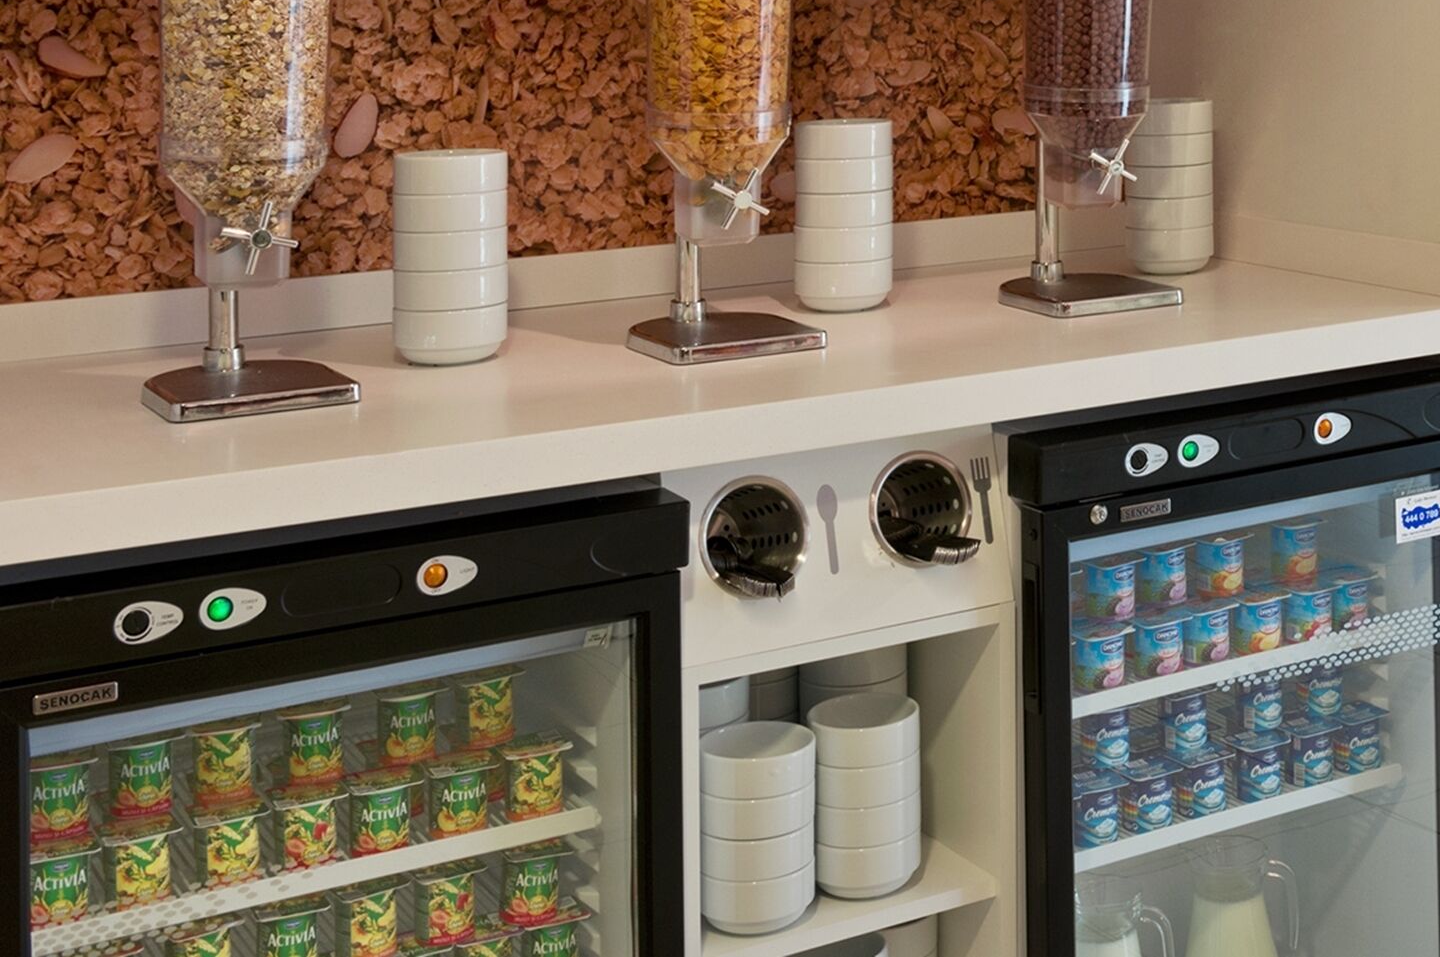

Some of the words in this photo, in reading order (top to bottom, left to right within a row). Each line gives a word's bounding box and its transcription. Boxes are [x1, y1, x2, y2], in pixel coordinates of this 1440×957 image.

[1124, 502, 1169, 520] SENOCAK
[40, 687, 112, 711] SENOCAK
[390, 708, 435, 730] ACTIVIA
[291, 727, 339, 748] ACTIVIA
[121, 755, 170, 779] ACTIVIA
[33, 778, 86, 801] ACTIVIA
[441, 782, 487, 803] ACTIVIA
[360, 801, 408, 823] ACTIVIA
[34, 868, 87, 892] ACTIVIA
[515, 868, 559, 887] ACTIVIA
[267, 925, 316, 948] ACTIVIA
[532, 933, 576, 955] ACTIVIA
